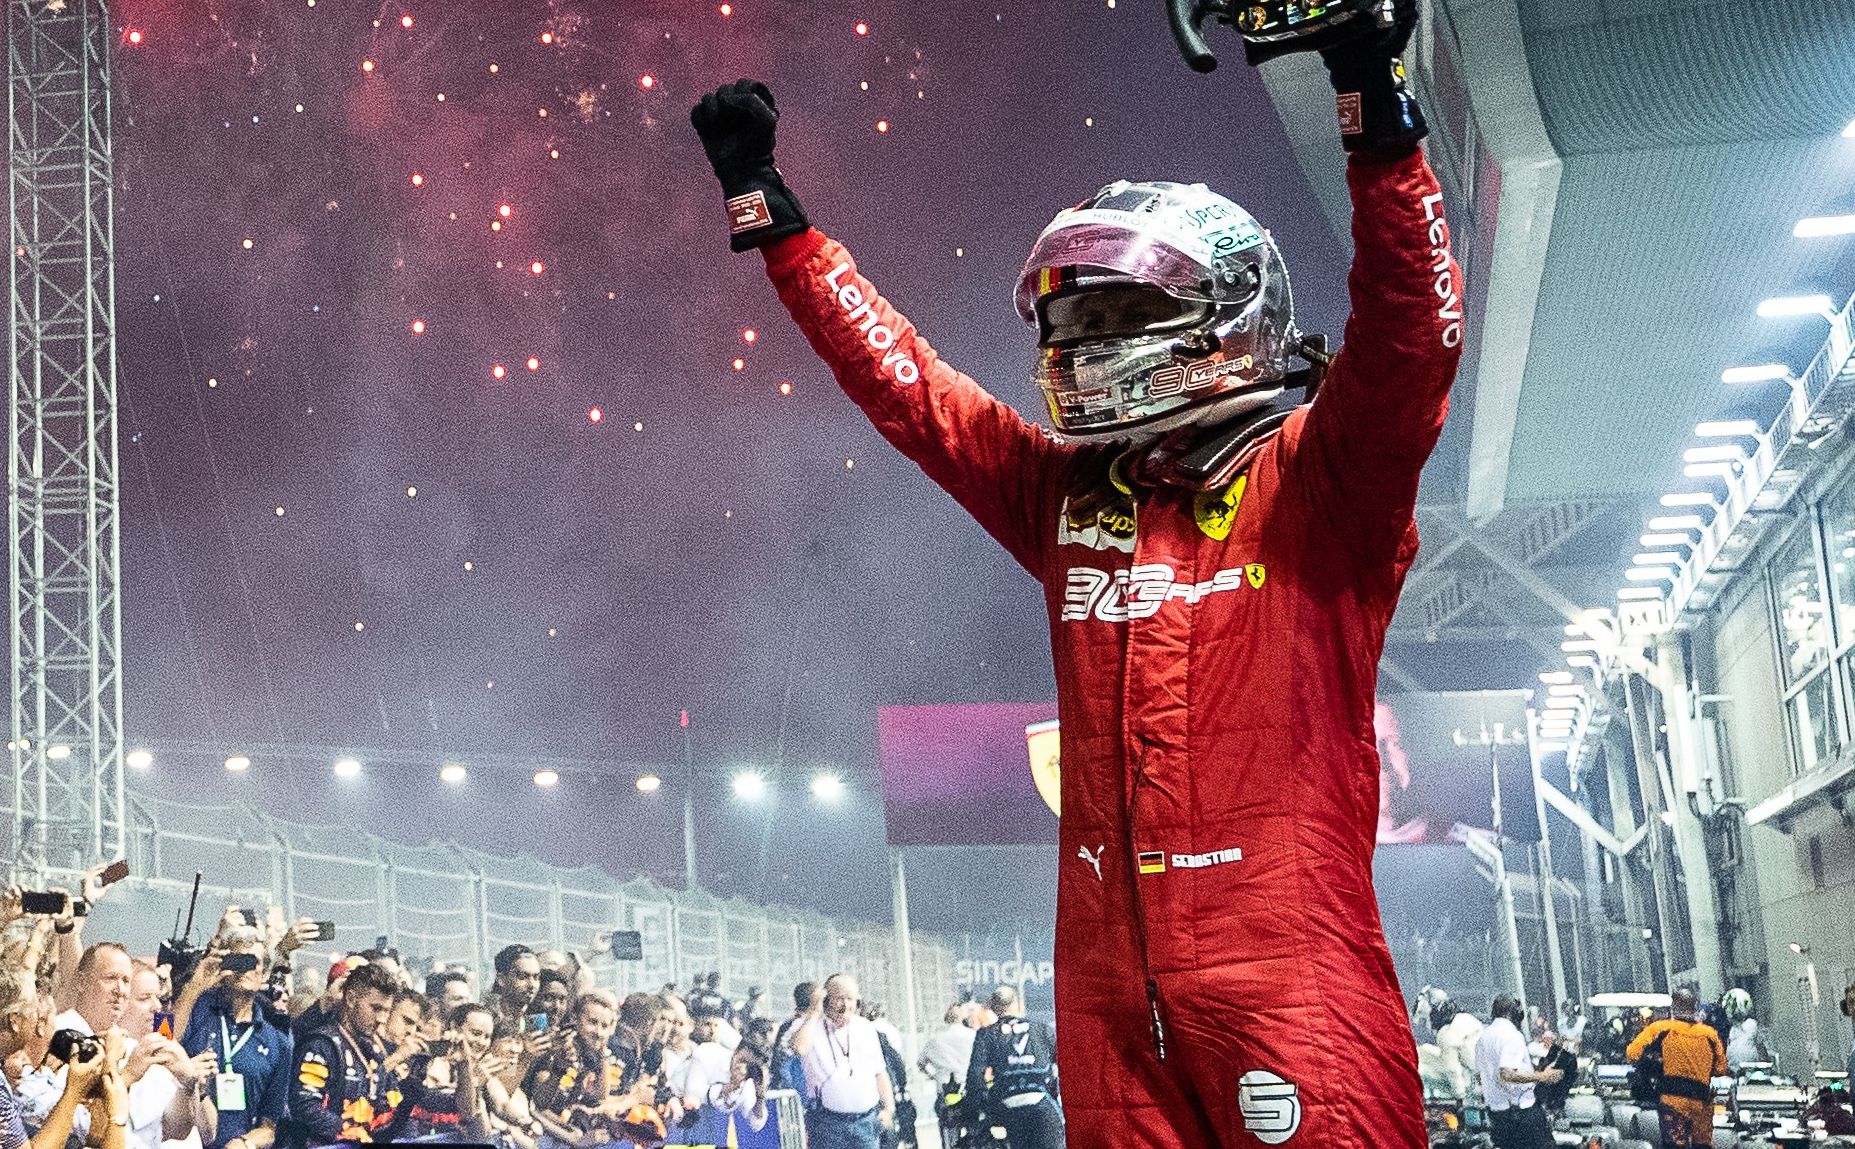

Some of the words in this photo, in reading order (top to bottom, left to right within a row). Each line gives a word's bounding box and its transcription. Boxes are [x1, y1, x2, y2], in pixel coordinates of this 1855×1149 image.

[1421, 192, 1461, 349] Lenovo
[824, 262, 920, 384] Lenovo
[1194, 360, 1244, 378] YEARS
[957, 959, 1054, 986] SINGAP
[1240, 1082, 1297, 1132] 5
